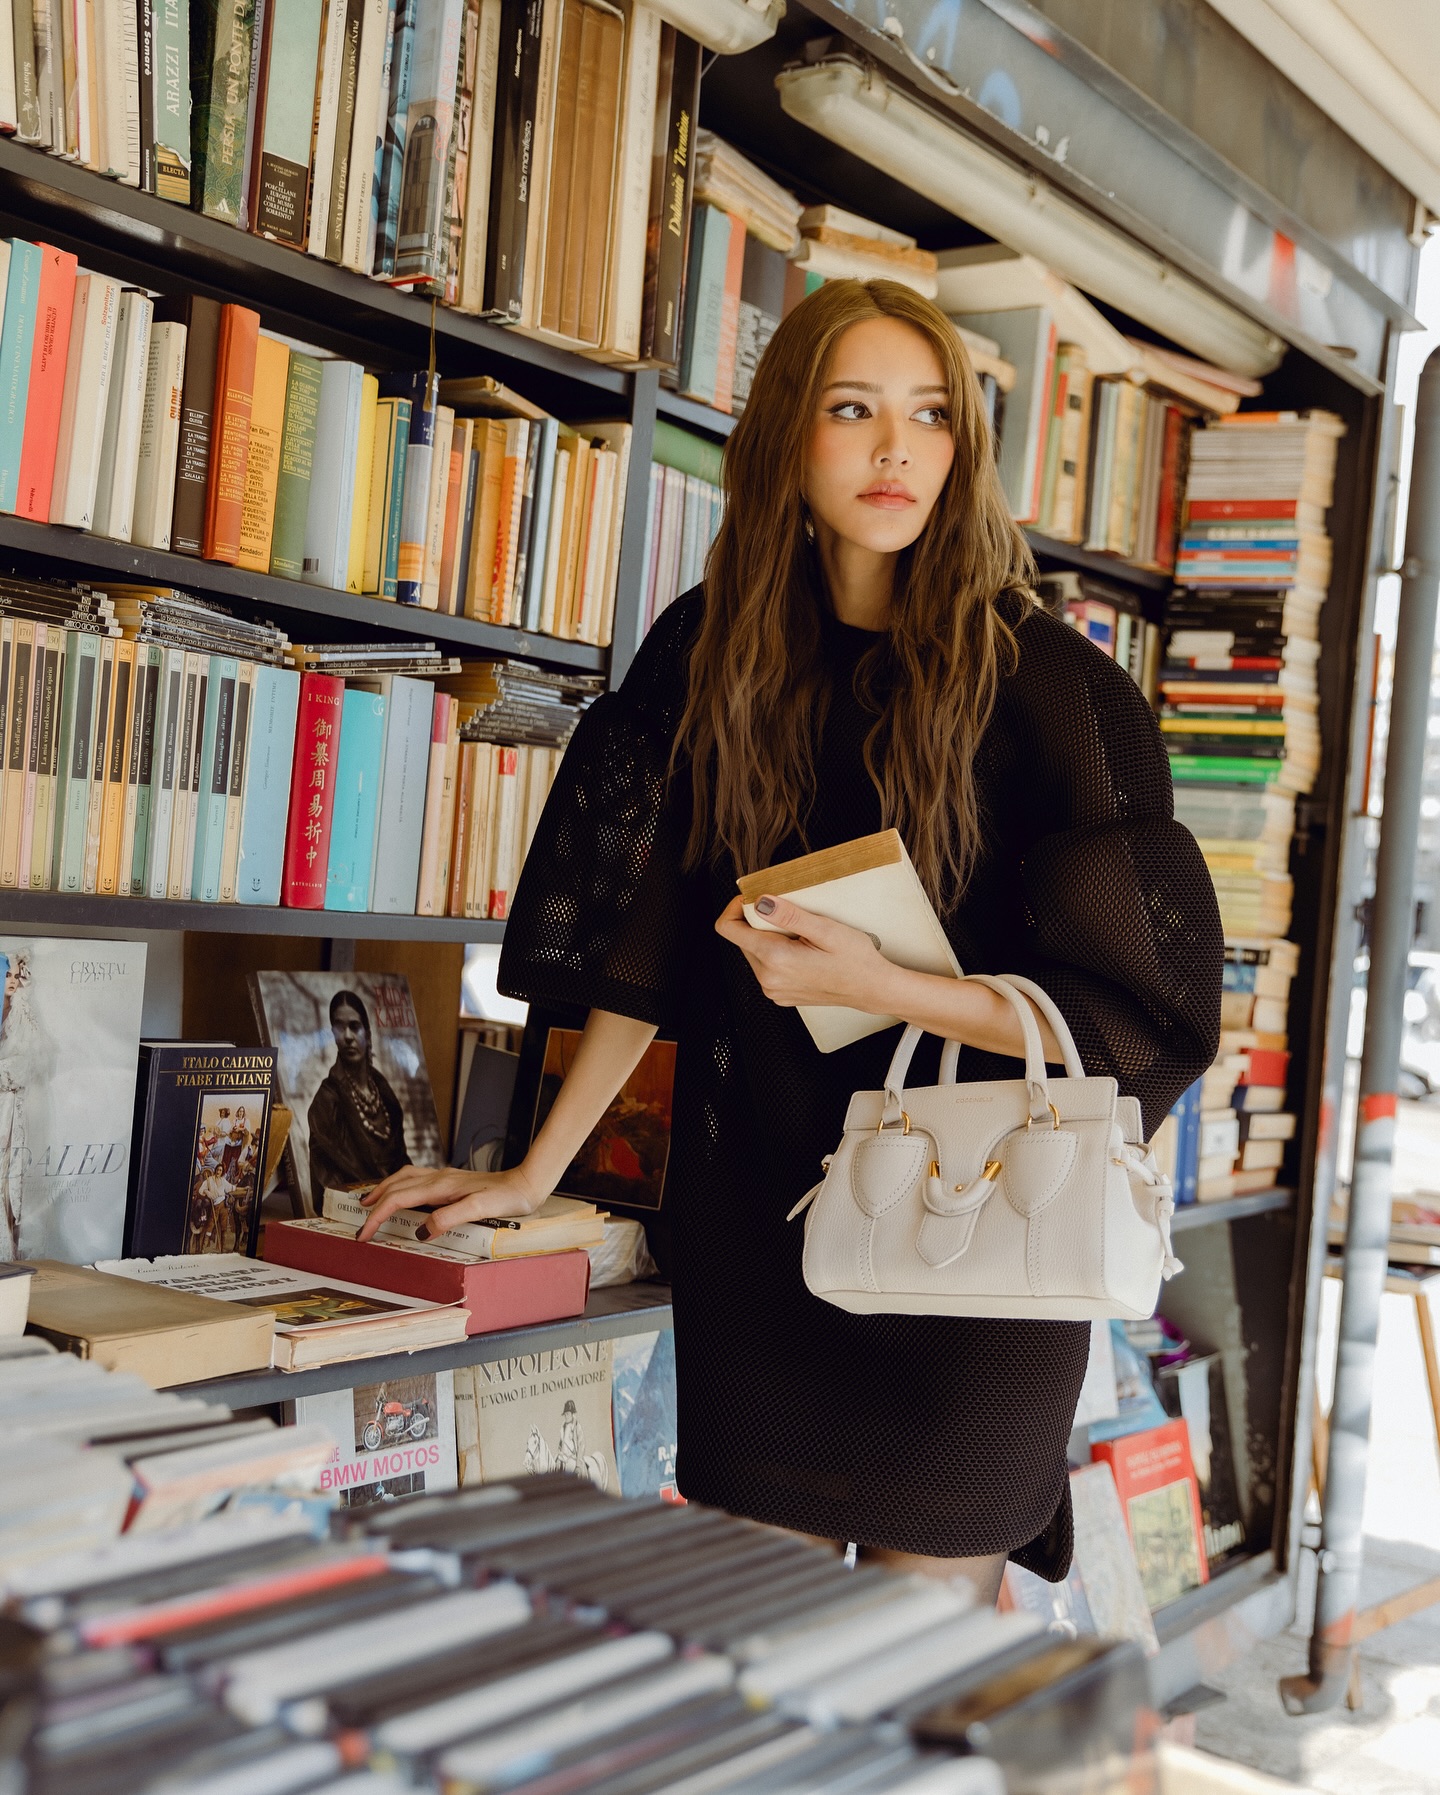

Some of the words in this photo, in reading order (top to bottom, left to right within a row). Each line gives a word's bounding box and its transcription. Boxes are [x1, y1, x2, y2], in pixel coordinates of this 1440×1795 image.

[251, 0, 262, 47] CHAGA
[386, 11, 396, 45] GIULIO
[229, 20, 244, 75] PONTE
[440, 16, 459, 98] NIEMEYER
[250, 56, 258, 92] MARC
[383, 46, 394, 88] TURCATO
[23, 62, 32, 101] Sabarsky
[166, 45, 180, 117] ARAZZI
[227, 81, 239, 104] UN
[222, 113, 237, 165] PERSIA
[434, 99, 454, 162] OSCAR
[162, 166, 185, 177] ELECTA
[337, 156, 348, 190] SPIEGEL
[264, 182, 297, 198] PORCELLANE
[518, 175, 529, 202] Italia
[336, 192, 345, 210] DER
[334, 212, 344, 240] VENUS
[22, 249, 33, 273] Cesare
[101, 285, 111, 326] Solzenitsyn
[107, 286, 116, 314] CAUSA
[15, 313, 25, 343] DIARIO
[141, 302, 150, 342] CORRENTE
[8, 345, 22, 424] CINEMATOGRAFICO
[227, 391, 242, 400] ELLERY
[189, 412, 204, 420] ELLERY
[259, 428, 270, 437] Dine
[252, 447, 265, 456] CASA
[253, 441, 274, 452] TRAGEDIA
[251, 455, 270, 464] MISTERO
[253, 461, 270, 471] DRAGO
[249, 474, 264, 482] GIOCO
[249, 480, 263, 488] FATTO
[248, 487, 267, 497] MISTERO
[257, 494, 268, 503] CASA
[246, 513, 267, 522] PERSONA
[253, 534, 267, 543] VANCE
[431, 523, 440, 555] CIPOLLA
[154, 605, 169, 614] Cuore
[149, 652, 158, 661] 15
[45, 666, 54, 685] spiriti
[33, 679, 41, 712] scacchiera
[44, 686, 53, 701] degli
[315, 693, 340, 706] KING
[12, 747, 20, 760] Vita
[17, 675, 25, 705] Avvakum
[31, 712, 39, 727] sulla
[43, 702, 51, 719] bosco
[30, 728, 39, 750] pedina
[71, 961, 130, 975] CRYSTAL
[372, 986, 409, 1007] FRIDA
[374, 1007, 416, 1028] KAHLO
[183, 1056, 219, 1069] ITALO
[221, 1056, 273, 1068] CALVINO
[175, 1074, 213, 1086] FIABE
[215, 1073, 272, 1086] ITALIANE
[0, 1143, 128, 1180] DALED
[337, 1203, 364, 1214] MISTERO
[398, 1217, 411, 1227] NEL
[491, 1219, 501, 1227] Non
[454, 1231, 465, 1239] cura
[150, 1267, 271, 1285] VALCATA
[479, 1341, 609, 1388] NAPOLEONE
[521, 1386, 528, 1399] E
[530, 1383, 539, 1396] IL
[542, 1369, 606, 1394] DOMINATORE
[320, 1460, 368, 1490] BMW
[373, 1444, 440, 1477] MOTOS
